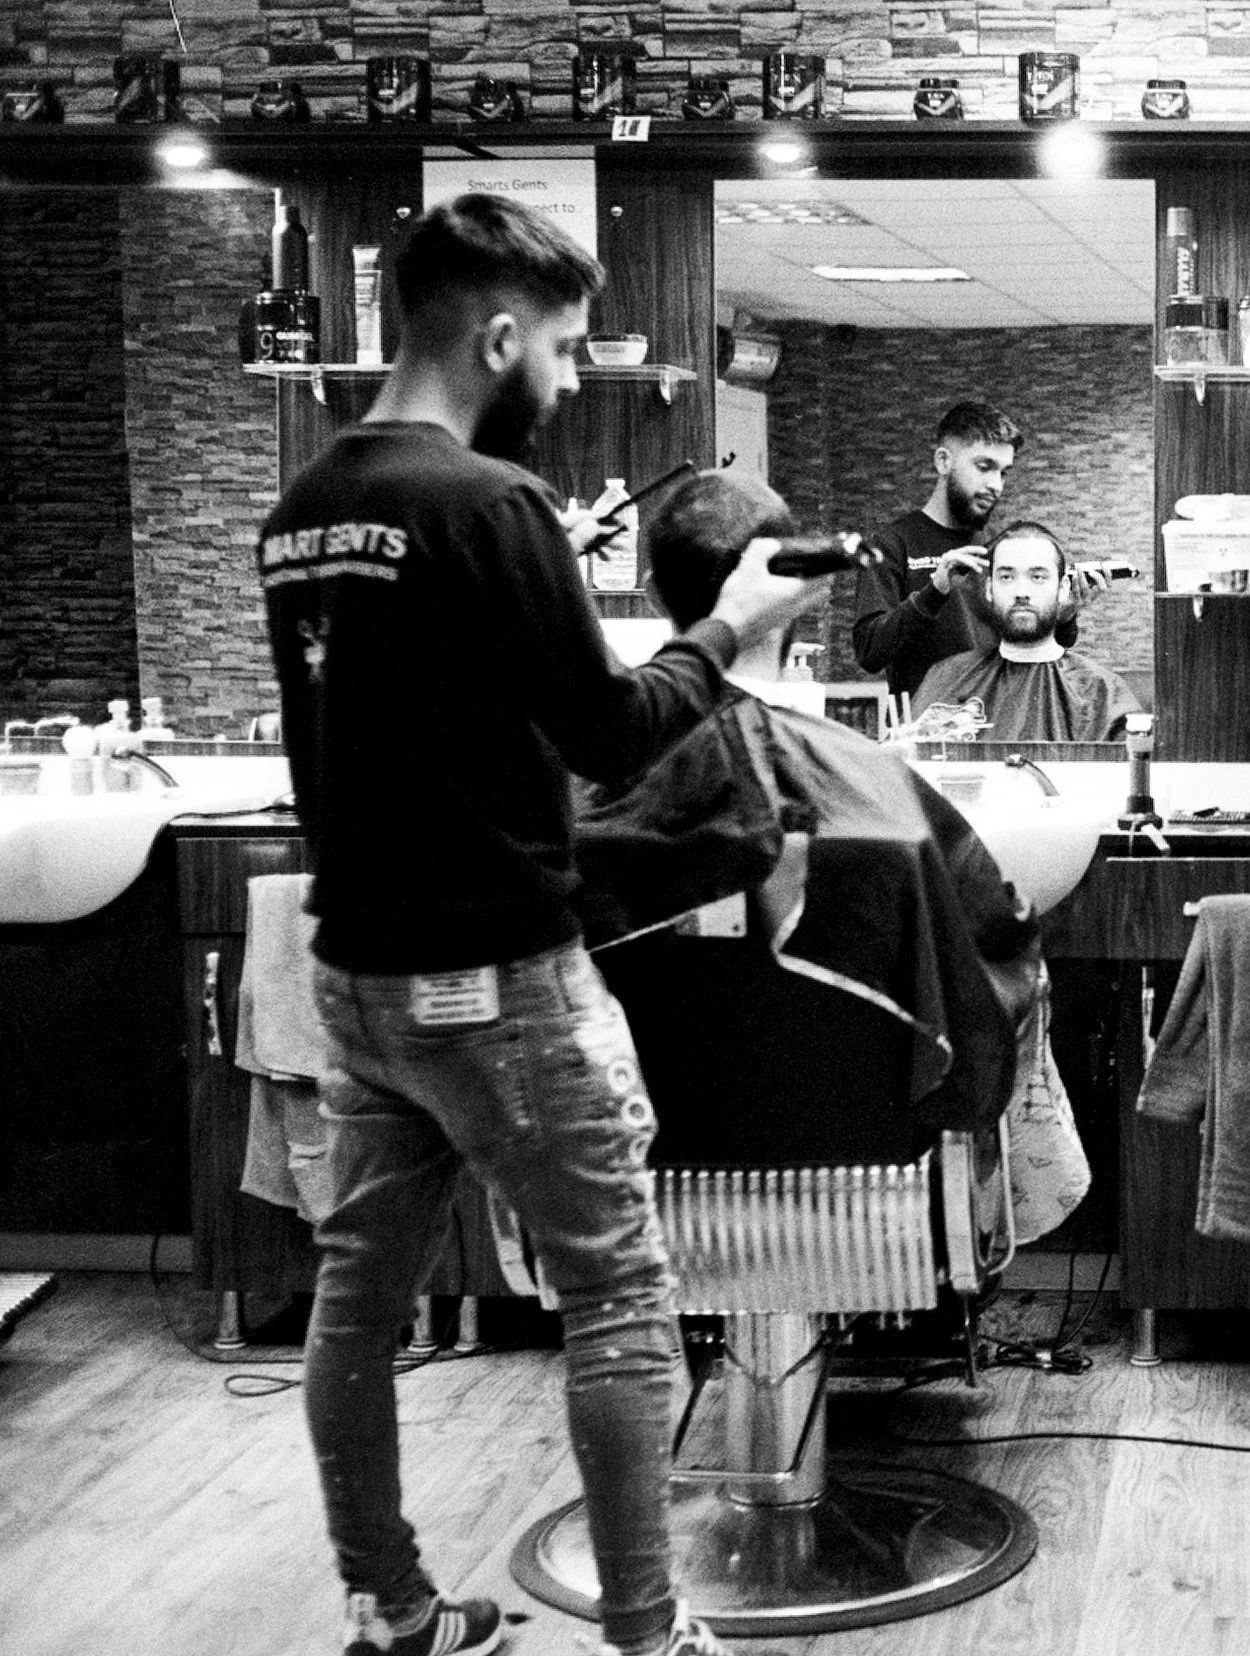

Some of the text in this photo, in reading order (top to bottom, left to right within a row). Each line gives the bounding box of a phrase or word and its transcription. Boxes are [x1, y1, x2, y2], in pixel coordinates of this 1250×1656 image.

[467, 179, 549, 191] Smarts Gents
[562, 202, 576, 213] to
[260, 332, 273, 360] 9
